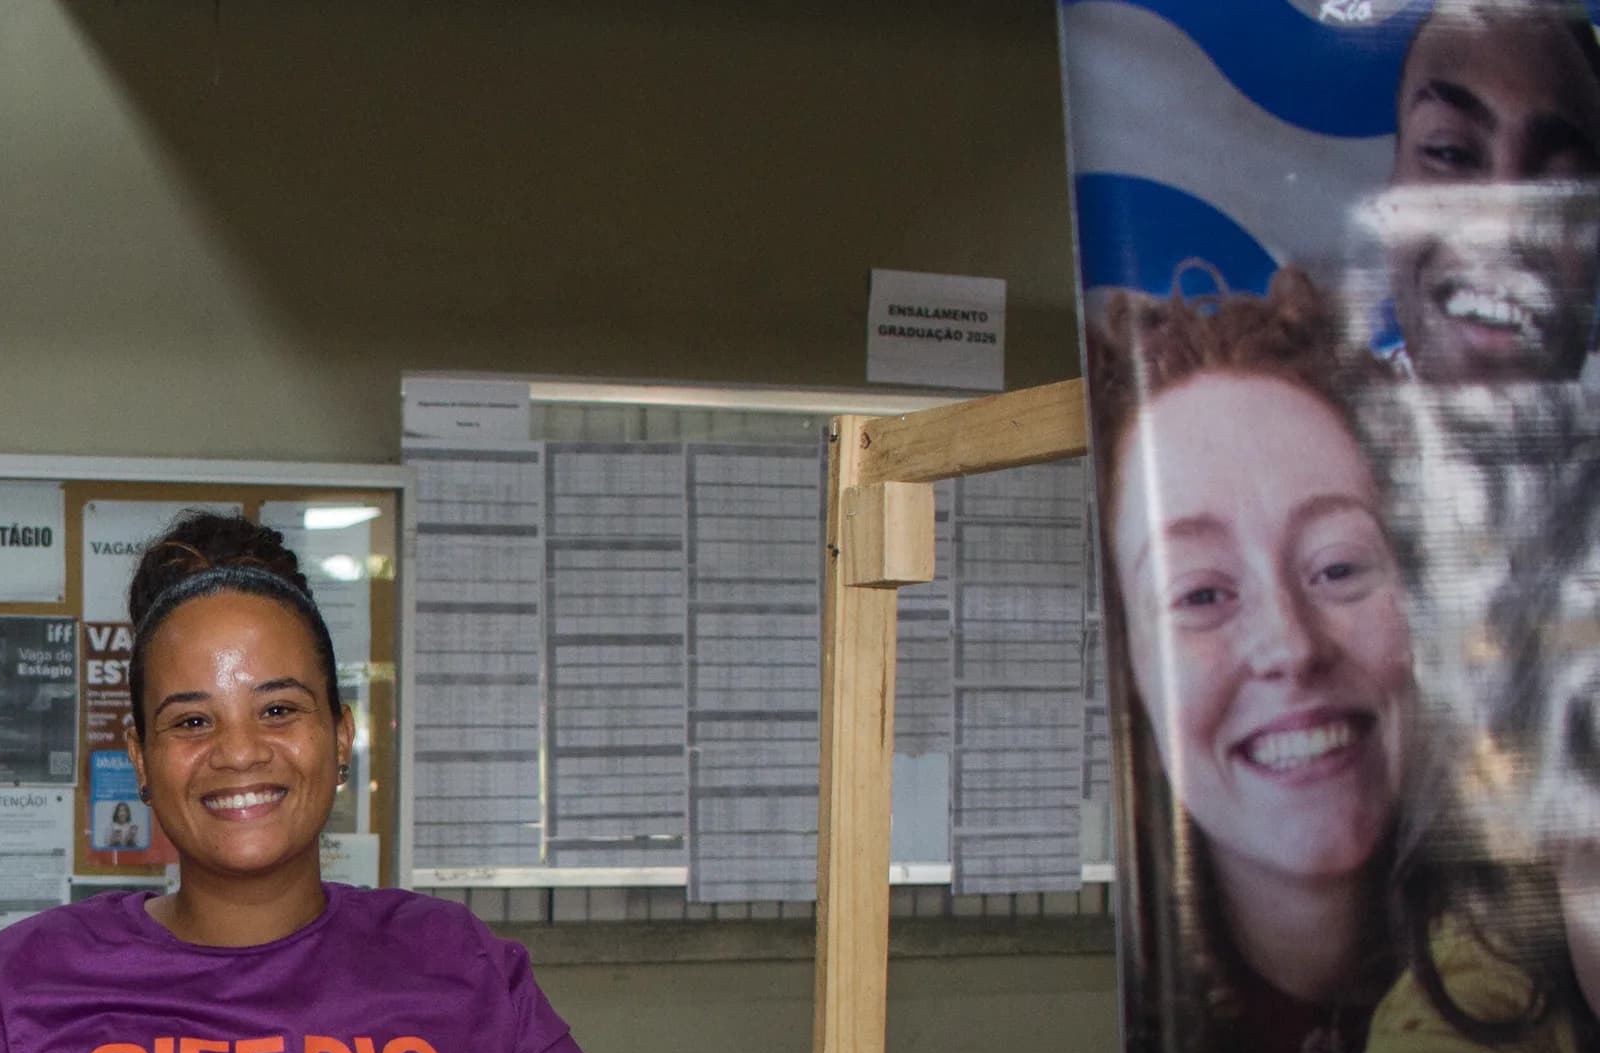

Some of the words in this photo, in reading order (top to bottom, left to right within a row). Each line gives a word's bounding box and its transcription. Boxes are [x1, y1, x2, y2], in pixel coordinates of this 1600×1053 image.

[888, 304, 988, 323] ENSALAMENTO
[878, 324, 962, 342] GRADUAÇÃO
[47, 623, 73, 643] iff
[20, 648, 53, 663] Vaga
[57, 648, 73, 660] de
[17, 663, 73, 678] Estágio
